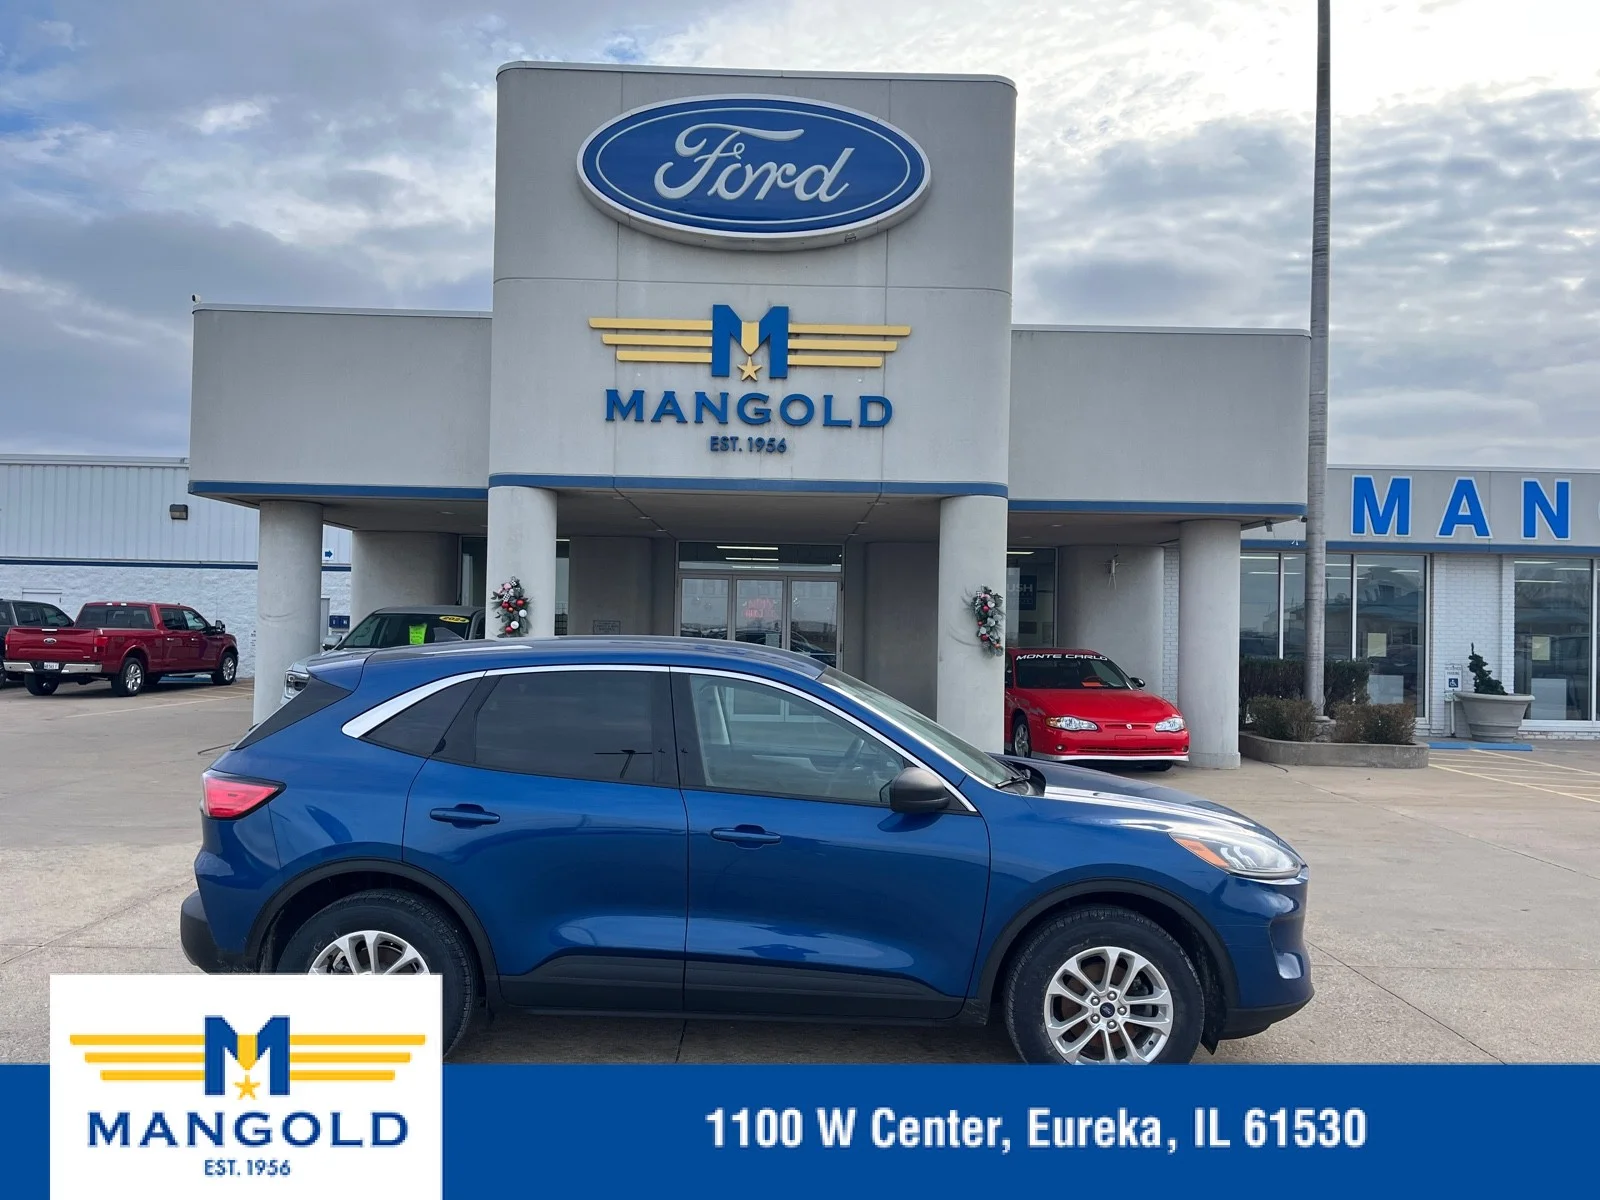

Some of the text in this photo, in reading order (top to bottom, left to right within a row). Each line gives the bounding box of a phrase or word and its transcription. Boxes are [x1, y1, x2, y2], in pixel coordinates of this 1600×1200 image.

[654, 123, 855, 203] Ford
[604, 389, 893, 428] MANGOLD
[710, 436, 787, 453] EST. 1956
[1351, 475, 1600, 541] MAN
